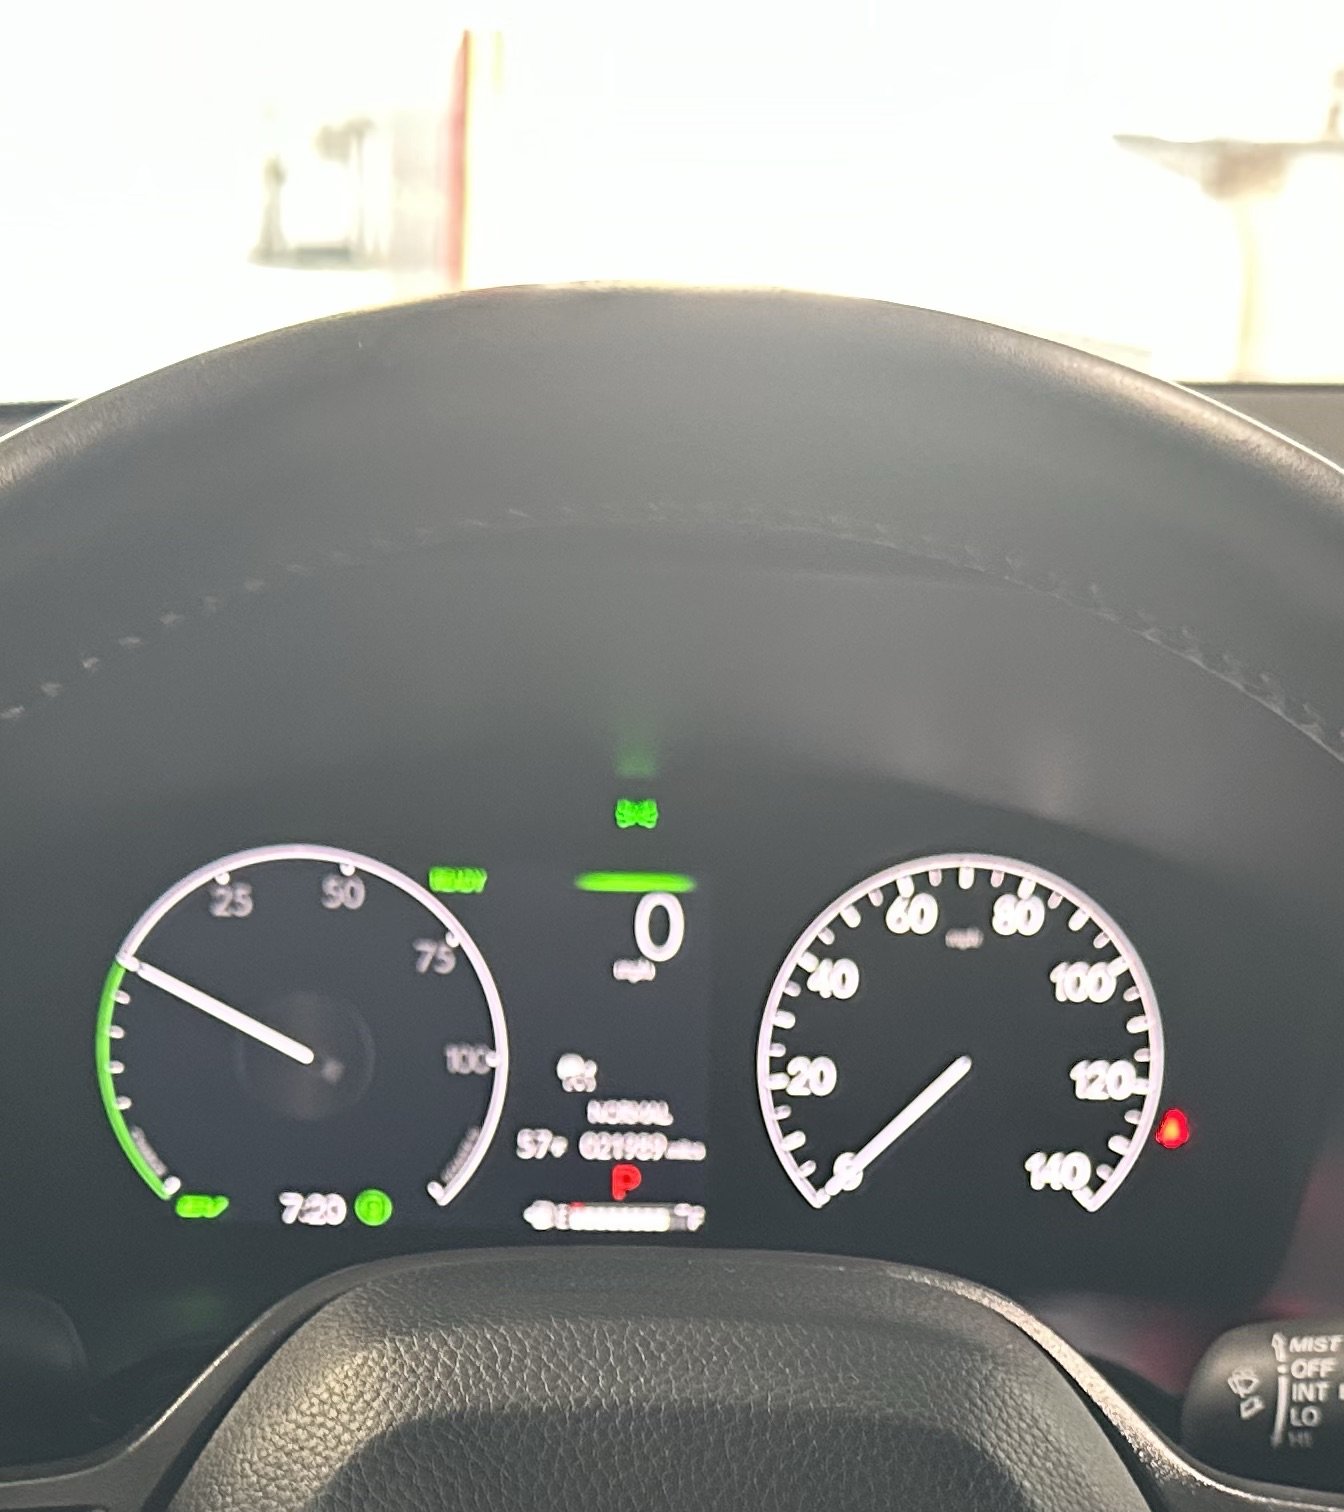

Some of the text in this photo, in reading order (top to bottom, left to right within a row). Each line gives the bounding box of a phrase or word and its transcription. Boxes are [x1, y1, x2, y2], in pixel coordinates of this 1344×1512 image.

[209, 882, 253, 917] 25
[321, 875, 365, 910] 50
[634, 891, 685, 963] 0
[886, 892, 938, 934] 60
[992, 894, 1045, 936] 80
[412, 938, 456, 974] 75
[806, 957, 860, 1000] 40
[1050, 961, 1117, 1003] 100
[445, 1043, 490, 1074] 100
[786, 1055, 837, 1097] 20
[1070, 1060, 1137, 1101] 120
[611, 1164, 642, 1201] P
[1024, 1151, 1092, 1192] 140
[1289, 1334, 1344, 1353] MIST
[1291, 1358, 1338, 1379] OFF
[1291, 1381, 1331, 1402] INT
[1290, 1405, 1322, 1427] LO
